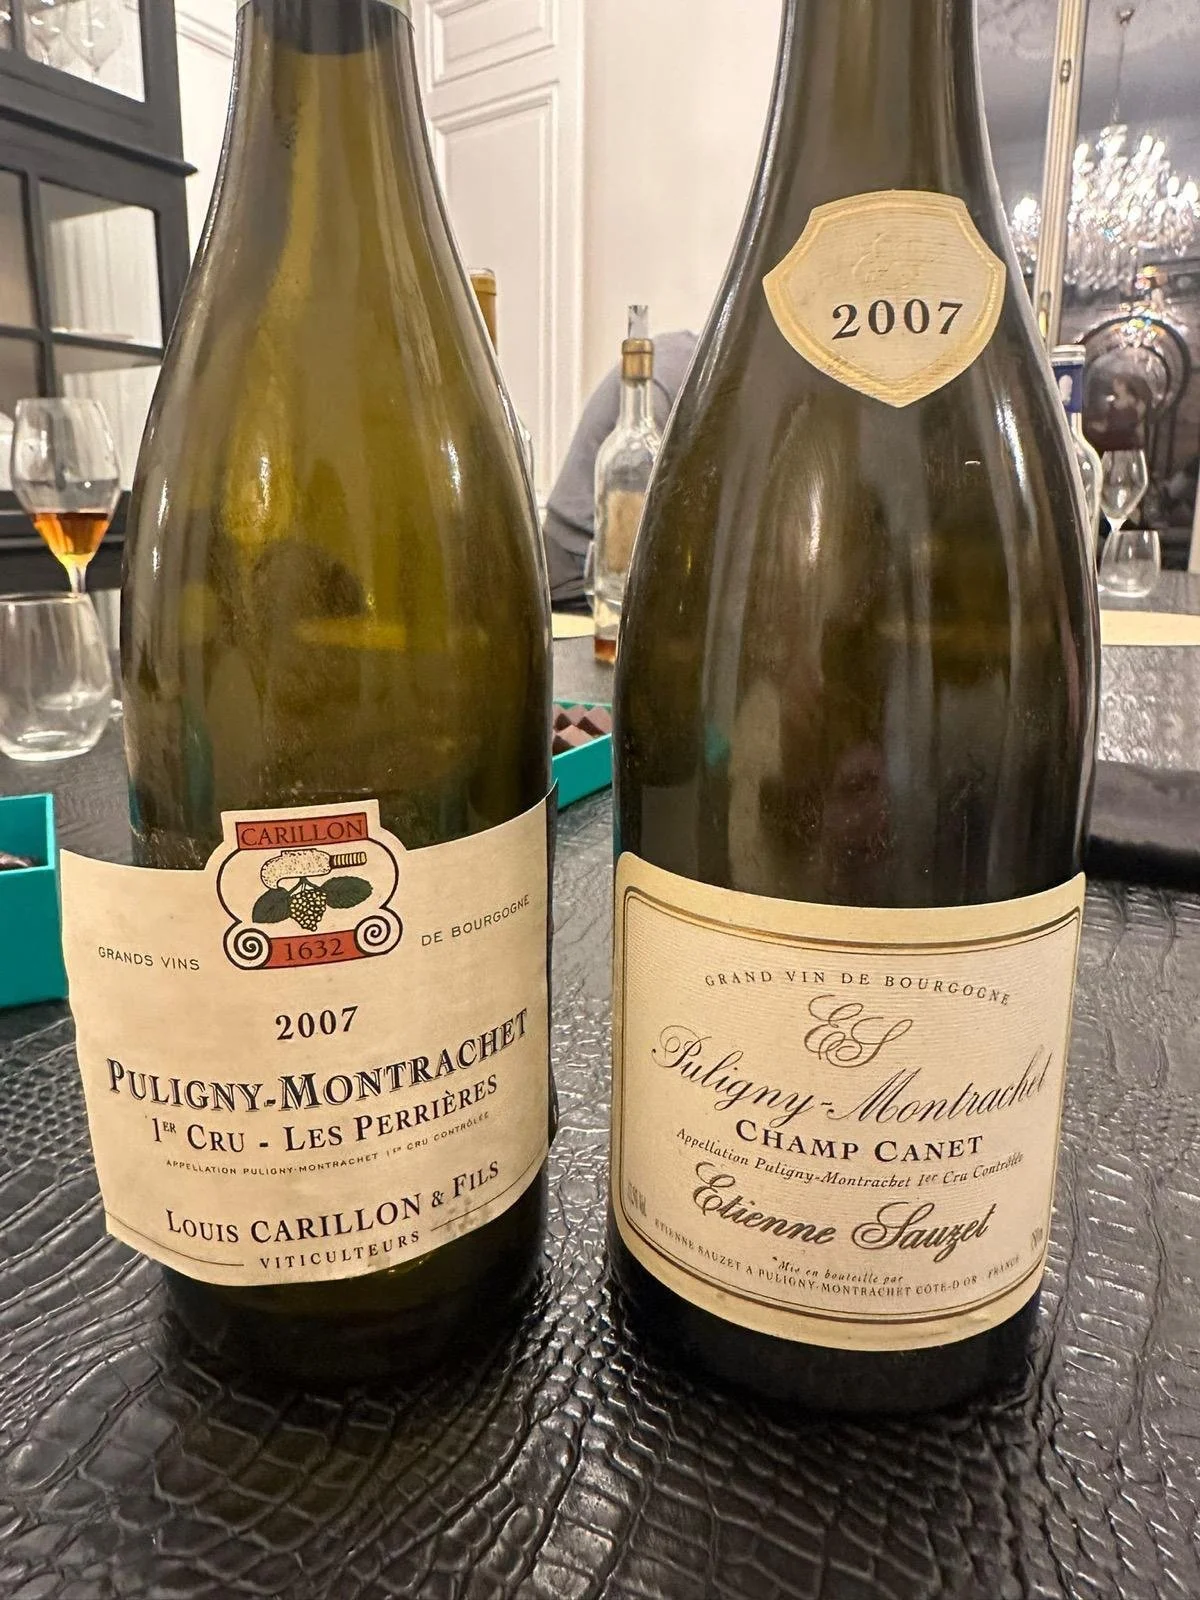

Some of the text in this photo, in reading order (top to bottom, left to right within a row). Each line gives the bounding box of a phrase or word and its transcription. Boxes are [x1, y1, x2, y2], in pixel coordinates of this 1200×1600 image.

[832, 299, 963, 340] 2007
[241, 819, 363, 847] CARILLON
[421, 894, 530, 947] DE BOURGOGNE
[98, 946, 201, 971] GRANDS VINS
[286, 938, 344, 961] 1632
[705, 970, 1011, 1007] GRAND VIN DE BOURGOGNE
[275, 1005, 359, 1041] 2007
[105, 1008, 528, 1113] PULIGNY-MONTRACHET
[651, 1024, 1053, 1129] Puligny-Montrachet
[151, 1117, 177, 1143] 1ER
[187, 1124, 246, 1153] CRU
[283, 1124, 343, 1152] LES
[353, 1074, 499, 1142] PERRIÈRES
[165, 1159, 237, 1175] APPELLATION
[243, 1153, 379, 1176] PULIGNY-MONTRACHET
[406, 1138, 429, 1151] CRU
[676, 1127, 750, 1166] Appellation
[754, 1156, 911, 1188] Puligny-Montrachet
[943, 1170, 968, 1184] Cru
[735, 1118, 984, 1163] CHAMP CANET
[165, 1160, 500, 1244] LOUIS CARILLON & FILS
[692, 1160, 837, 1246] Etienne
[851, 1201, 997, 1264] Sauzet
[259, 1229, 420, 1269] VITICULTEURS
[697, 1245, 742, 1272] SAUZET
[824, 1268, 879, 1285] bouteille
